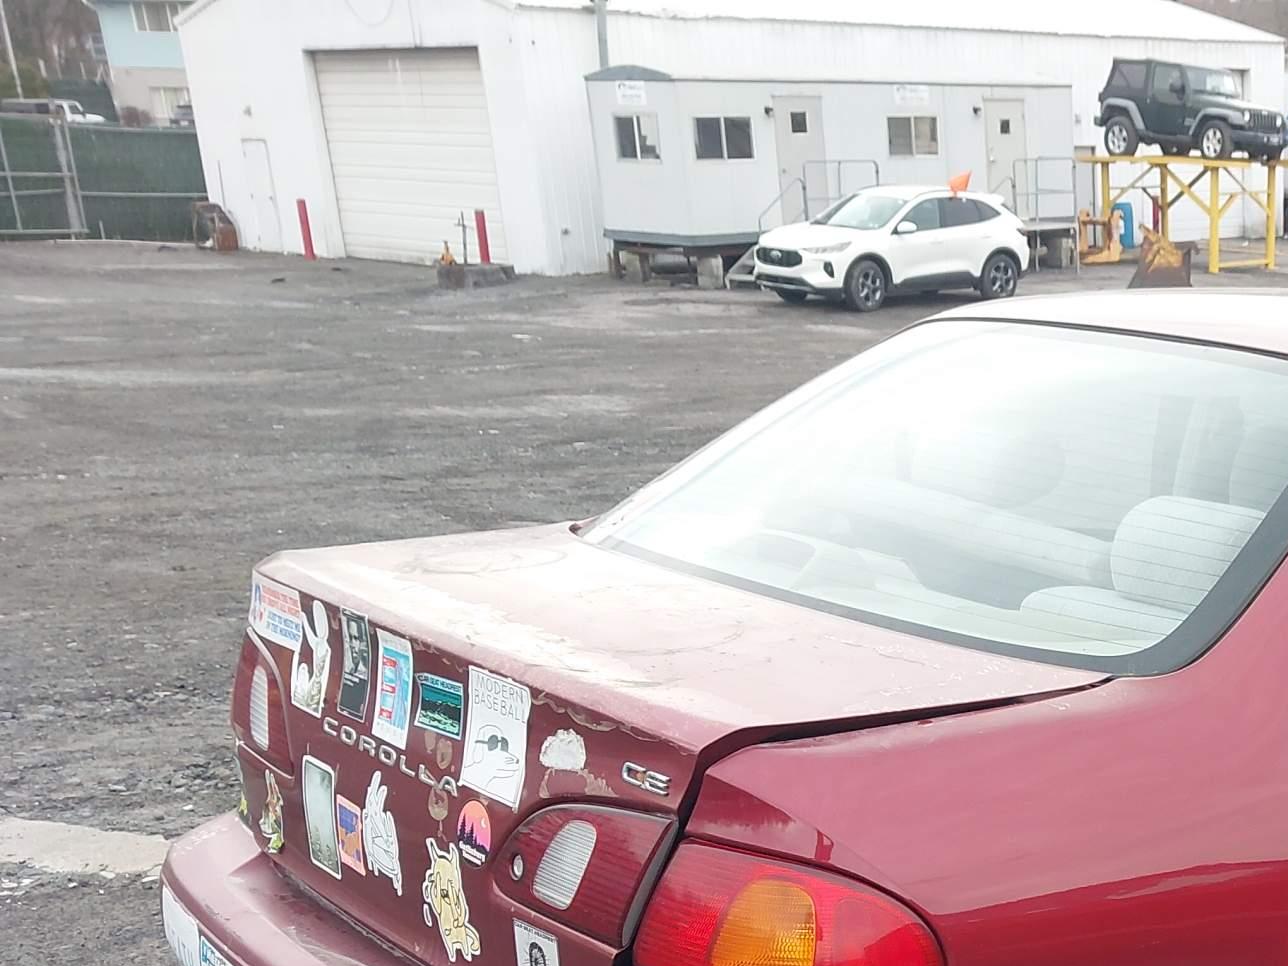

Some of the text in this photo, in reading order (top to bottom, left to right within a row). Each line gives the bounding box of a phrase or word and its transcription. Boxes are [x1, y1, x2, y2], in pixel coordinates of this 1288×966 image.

[473, 673, 523, 704] MODERN
[474, 688, 526, 724] BASEBALL
[322, 716, 458, 798] COROLLA
[621, 761, 671, 797] CE
